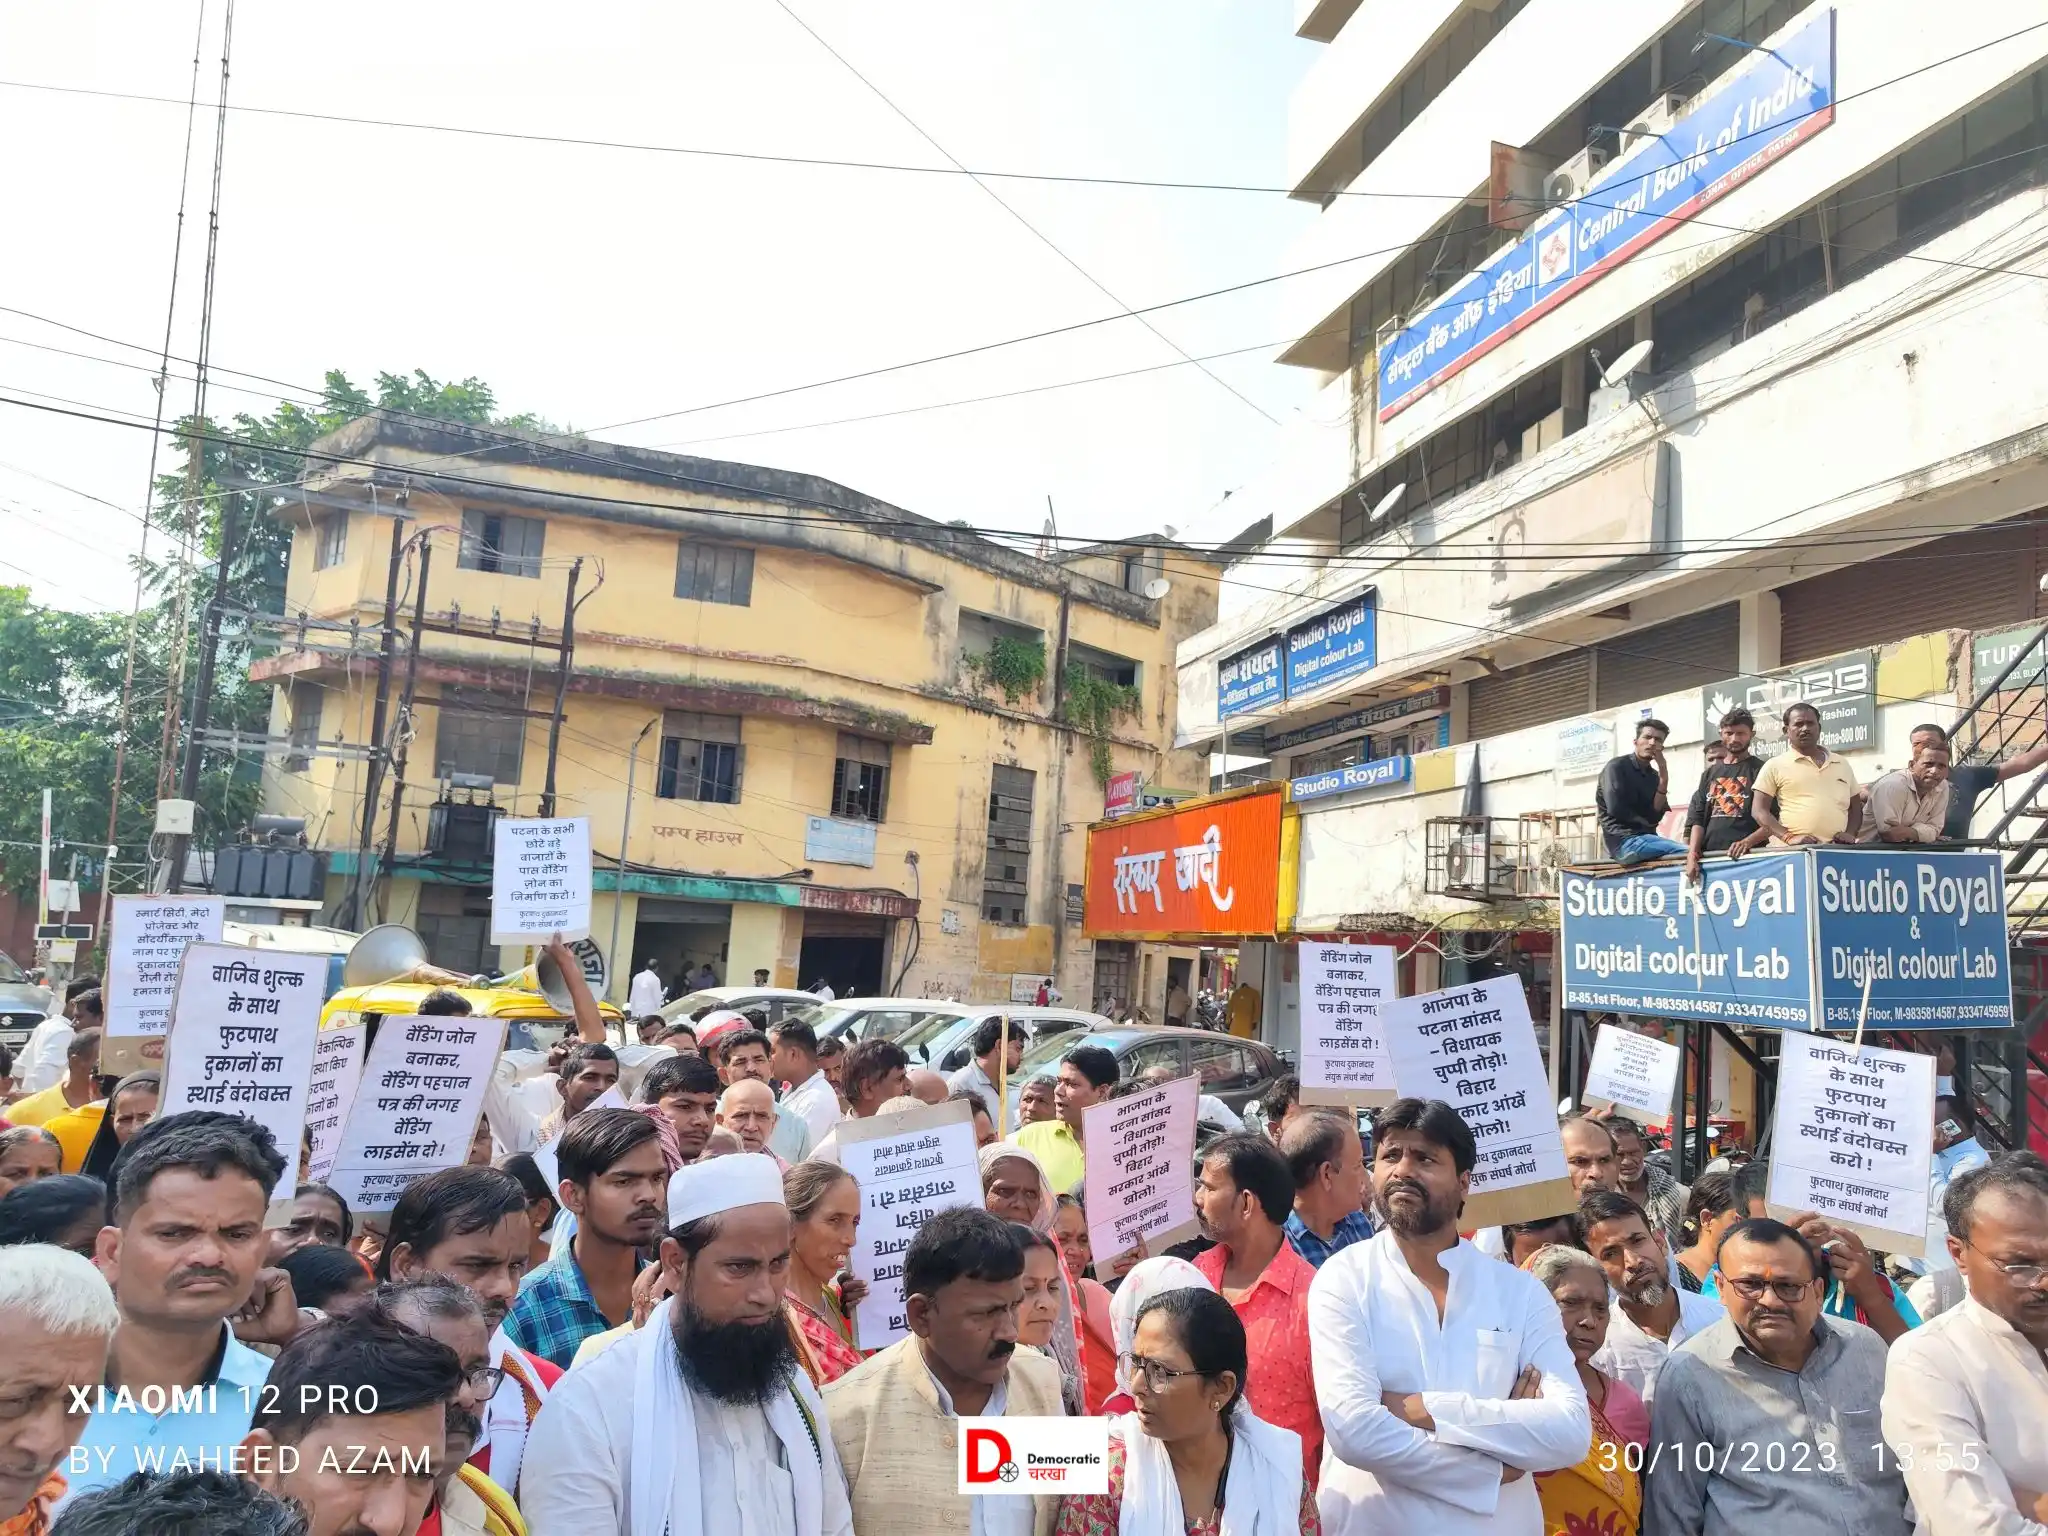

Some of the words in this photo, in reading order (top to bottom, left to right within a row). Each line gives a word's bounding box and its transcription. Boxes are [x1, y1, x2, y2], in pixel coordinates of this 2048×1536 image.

[1768, 131, 1799, 156] PATNA
[1579, 178, 1648, 251] Central
[1653, 134, 1709, 202] Bank
[1716, 104, 1743, 156] of
[1748, 64, 1814, 134] India
[1426, 324, 1449, 354] बैंक
[1488, 263, 1532, 315] इंडिया
[1290, 625, 1325, 652] Studio
[1328, 606, 1365, 637] Royal
[1295, 656, 1319, 677] Digital
[1320, 647, 1346, 667] colour
[1348, 639, 1364, 656] Lab
[1822, 706, 1857, 721] fashion
[1756, 739, 1787, 756] Shopping
[1820, 728, 1853, 746] Patna-800
[1855, 725, 1868, 741] 001
[1295, 777, 1339, 796] Studio
[1344, 761, 1393, 785] Royal
[511, 828, 538, 836] पटना
[541, 826, 551, 835] के
[553, 823, 575, 834] सभी
[653, 825, 691, 840] पम्प
[696, 830, 744, 847] हाउस
[525, 838, 545, 848] छोटे
[556, 851, 567, 861] के
[1173, 824, 1233, 912] खादी
[549, 879, 563, 887] का
[510, 891, 547, 901] निर्माण
[549, 890, 569, 900] करो
[1566, 877, 1665, 917] Studio
[1678, 864, 1795, 927] Royal
[1821, 865, 1908, 913] Studio
[1916, 864, 1997, 927] Royal
[136, 908, 161, 918] स्मार्ट
[145, 922, 179, 931] प्रोजेक्ट
[181, 921, 199, 930] और
[1665, 916, 1679, 939] &
[1910, 915, 1921, 939] &
[132, 948, 155, 957] नाम
[156, 948, 169, 956] पर
[1320, 949, 1347, 963] वेंडिंग
[1349, 951, 1372, 965] जोन
[1575, 943, 1642, 978] Digital
[1649, 945, 1729, 977] colour
[1737, 947, 1790, 979] Lab
[139, 972, 161, 983] रोज़ी
[212, 961, 260, 985] वाजिब
[263, 970, 304, 993] शुल्क
[1326, 969, 1367, 982] बनाकर,
[1831, 946, 1893, 988] Digital
[1899, 947, 1959, 980] colour
[1963, 947, 1997, 978] Lab
[133, 988, 161, 996] हमला
[1315, 984, 1342, 997] वेंडिंग
[1344, 987, 1381, 999] पहचान
[1422, 993, 1470, 1015] भाजपा
[1473, 987, 1489, 1007] के
[1568, 991, 1609, 1005] B-85,1st
[1610, 994, 1640, 1008] Floor,
[228, 991, 245, 1013] के
[246, 997, 280, 1015] साथ
[1318, 1003, 1334, 1014] पत्र
[1336, 1001, 1350, 1014] की
[1335, 1018, 1362, 1031] वेंडिंग
[1417, 1016, 1458, 1037] पटना
[1460, 1007, 1503, 1030] सांसद
[219, 1026, 279, 1050] फुटपाथ
[317, 1036, 356, 1055] वैकल्पिक
[406, 1025, 444, 1044] वेंडिंग
[446, 1027, 477, 1045] जोन
[1319, 1035, 1359, 1050] लाइसेंस
[1361, 1036, 1372, 1049] दो
[1442, 1031, 1502, 1057] विधायक
[204, 1051, 261, 1080] दुकानों
[261, 1056, 283, 1073] का
[329, 1056, 348, 1071] किए
[406, 1051, 460, 1069] बनाकर,
[1325, 1060, 1346, 1070] फुटपाथ
[1347, 1060, 1375, 1070] दुकानदार
[1433, 1058, 1468, 1083] चुप्पी
[1471, 1052, 1508, 1076] तोड़ो!
[1863, 1057, 1907, 1075] शुल्क
[381, 1071, 420, 1089] वेंडिंग
[423, 1076, 472, 1091] पहचान
[1325, 1073, 1341, 1083] संयुक्त
[1344, 1073, 1358, 1081] संघर्ष
[1360, 1072, 1374, 1082] मोर्चा
[1456, 1078, 1497, 1098] बिहार
[1829, 1066, 1846, 1082] के
[1849, 1072, 1885, 1090] साथ
[187, 1080, 229, 1104] स्थाई
[230, 1080, 292, 1102] बंदोबस्त
[326, 1093, 339, 1109] को
[1492, 1091, 1526, 1112] आंखें
[1825, 1087, 1887, 1110] फुटपाथ
[377, 1098, 402, 1111] पत्र
[402, 1094, 422, 1111] की
[425, 1099, 462, 1112] जगह
[1117, 1095, 1152, 1117] भाजपा
[1155, 1091, 1169, 1105] के
[327, 1115, 339, 1127] बंद
[394, 1117, 432, 1135] वेंडिंग
[1110, 1117, 1139, 1134] पटना
[1140, 1104, 1173, 1123] सांसद
[1814, 1105, 1871, 1127] दुकानों
[1872, 1117, 1896, 1133] का
[1124, 1121, 1168, 1144] विधायक
[1800, 1124, 1842, 1144] स्थाई
[1843, 1128, 1908, 1157] बंदोबस्त
[364, 1140, 420, 1161] लाइसेंस
[422, 1142, 438, 1158] दो
[1113, 1143, 1137, 1167] चुप्पी
[1490, 1144, 1532, 1163] दुकानदार
[1830, 1150, 1864, 1169] करो
[1125, 1156, 1154, 1175] बिहार
[1490, 1164, 1512, 1180] संघर्ष
[1514, 1159, 1536, 1174] मोर्चा
[362, 1174, 393, 1188] फुटपाथ
[1108, 1172, 1145, 1197] सरकार
[1146, 1160, 1171, 1181] आंखें
[1810, 1176, 1844, 1192] फुटपाथ
[1846, 1183, 1889, 1202] दुकानदार
[357, 1192, 382, 1205] संयुक्त
[880, 1192, 896, 1211] दो
[898, 1180, 956, 1206] लाइसेंस
[1123, 1185, 1157, 1206] खोलो!
[1114, 1211, 1138, 1232] फुटपाथ
[1139, 1199, 1168, 1222] दुकानदार
[1809, 1193, 1836, 1209] संयुक्त
[1838, 1199, 1863, 1215] संघर्ष
[1864, 1203, 1888, 1219] मोर्चा
[1138, 1220, 1153, 1238] संघर्ष
[1154, 1213, 1170, 1228] मोर्चा
